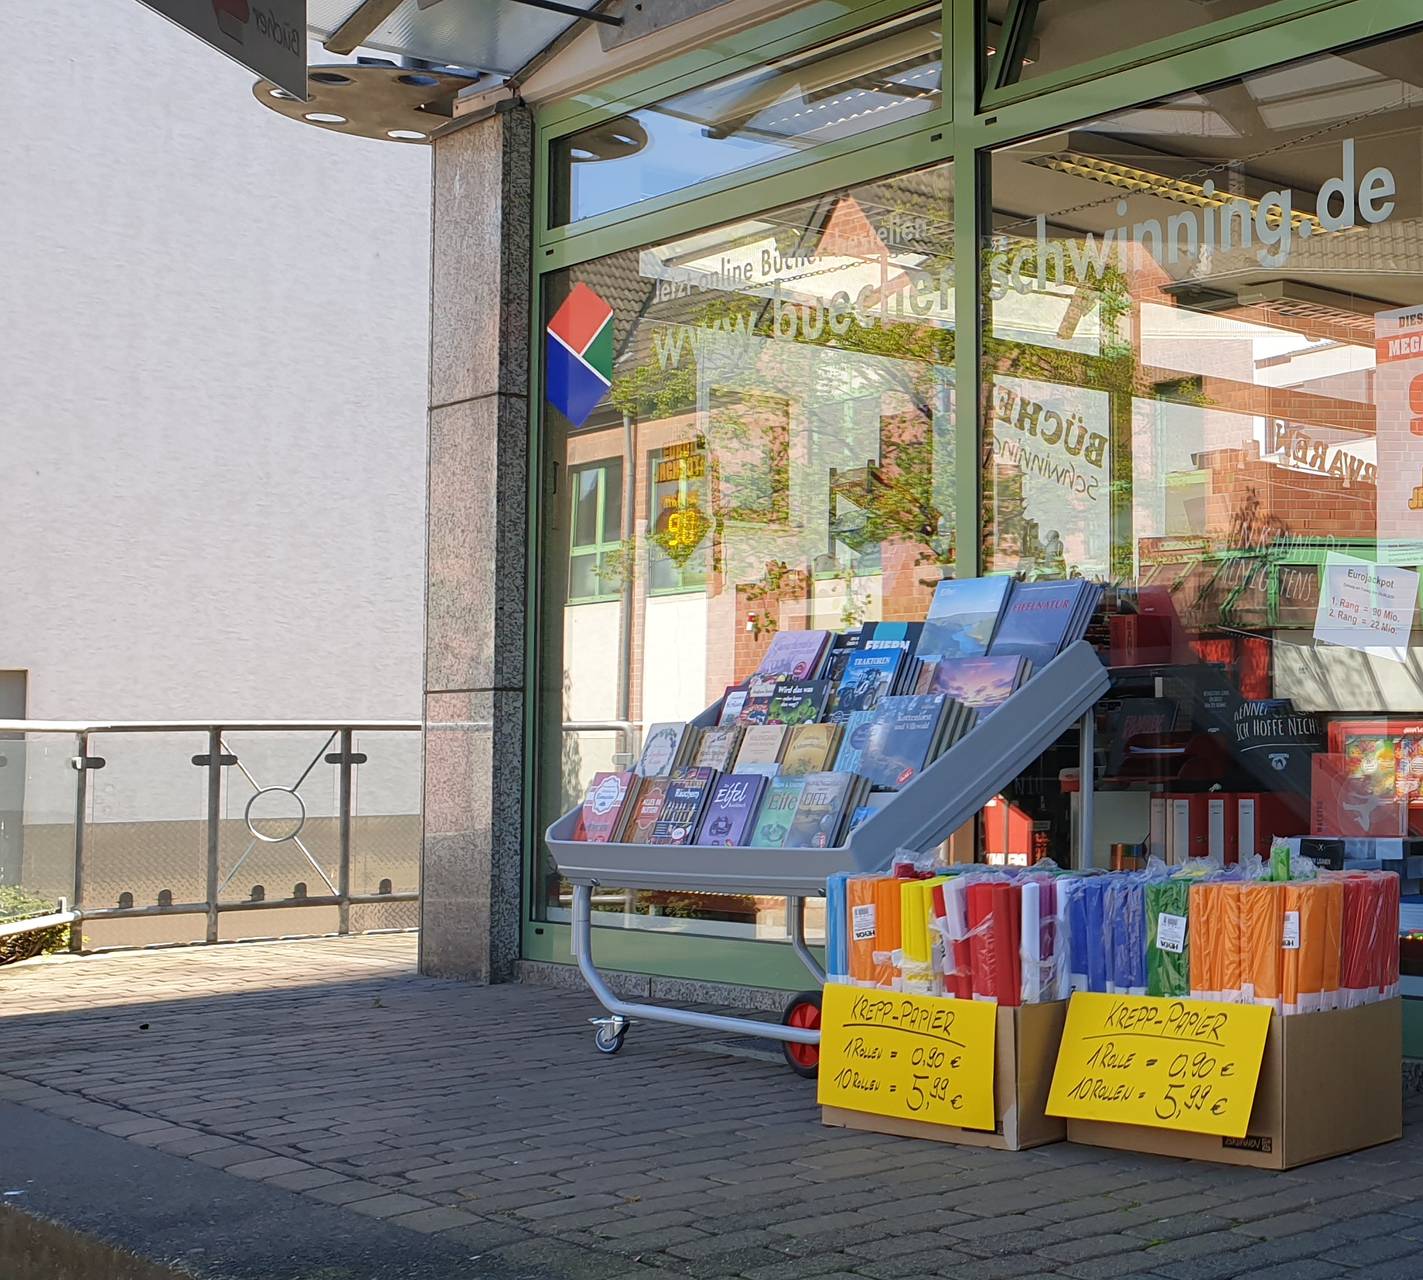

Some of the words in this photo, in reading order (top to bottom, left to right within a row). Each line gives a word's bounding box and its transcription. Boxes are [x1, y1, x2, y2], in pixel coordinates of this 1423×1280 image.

[700, 257, 753, 290] online
[1347, 568, 1395, 590] Eurojackpot
[1328, 608, 1336, 620] 2.
[1337, 610, 1358, 626] Rang
[1370, 619, 1380, 630] 22
[1381, 623, 1398, 636] Mio.
[1339, 598, 1361, 614] Rang
[1372, 606, 1382, 618] 90
[1383, 610, 1400, 623] Mio.
[1236, 722, 1250, 741] ICH
[1253, 718, 1285, 737] HOFFE
[850, 994, 956, 1037] KREPP-PAPIER
[1104, 1000, 1228, 1041] KREPP-PAPIER
[911, 1046, 946, 1069] 0,90
[950, 1055, 962, 1069] €
[1167, 1051, 1217, 1079] 0,90
[1220, 1062, 1235, 1077] €
[905, 1073, 950, 1112] 5,99
[950, 1094, 965, 1111] €
[1154, 1084, 1213, 1120] 5,99
[1210, 1097, 1229, 1116] €
